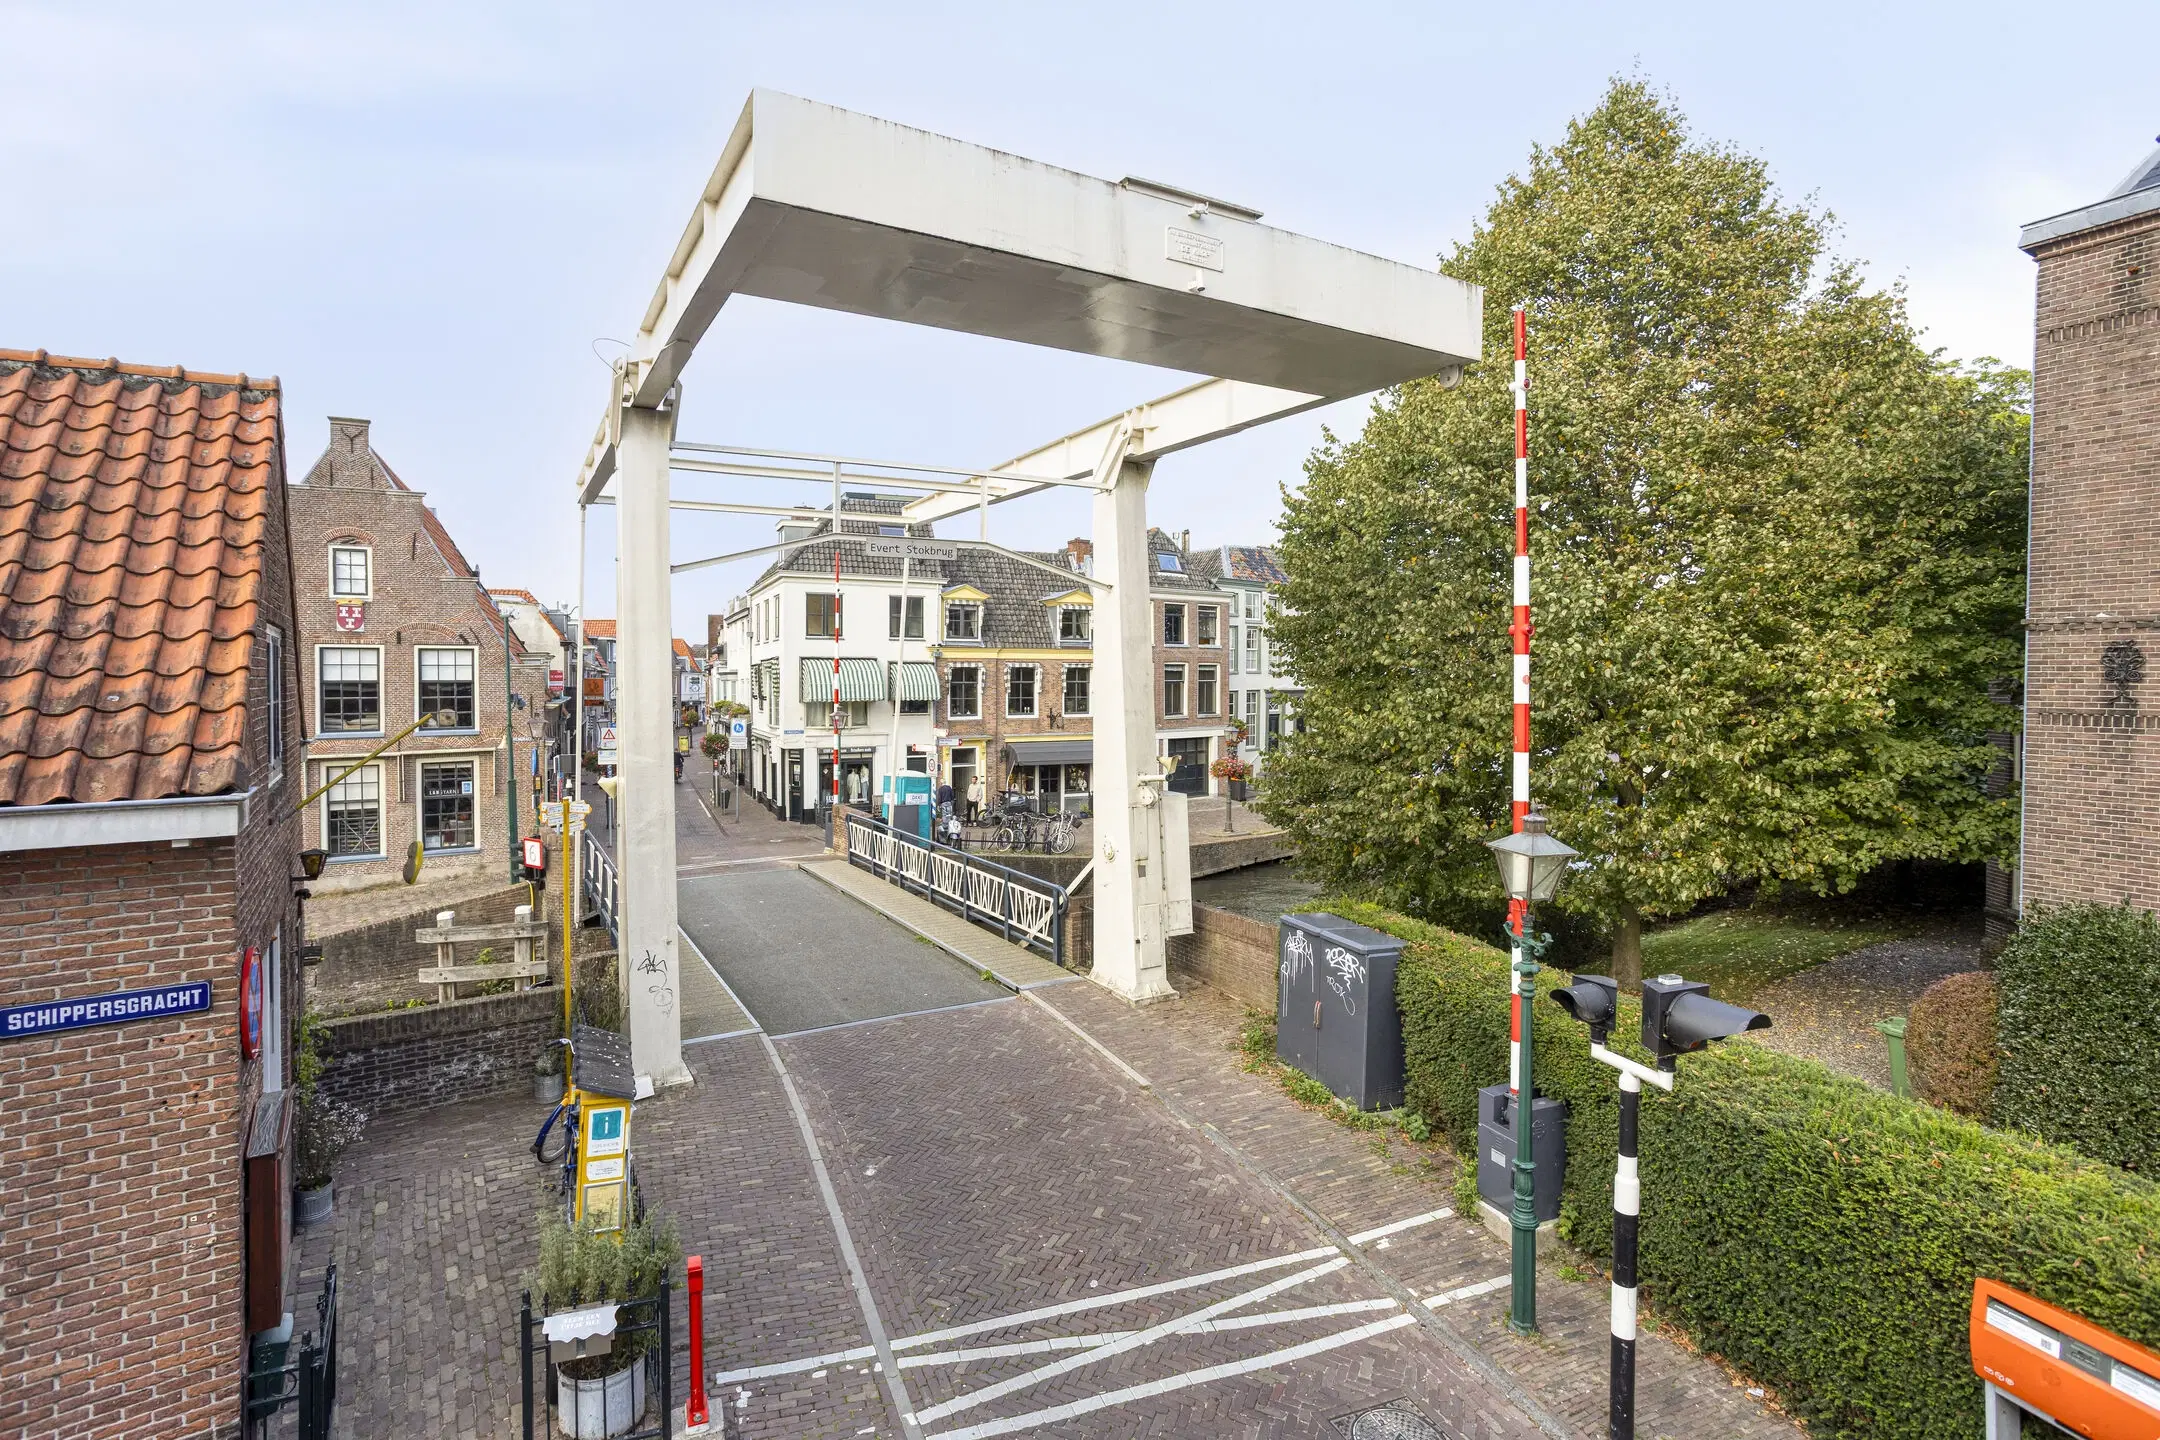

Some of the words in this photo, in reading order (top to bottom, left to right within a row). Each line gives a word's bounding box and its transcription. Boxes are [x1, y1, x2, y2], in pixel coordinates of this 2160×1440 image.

[870, 543, 900, 553] Evert
[906, 544, 953, 558] Stokbrug
[529, 844, 537, 862] 6
[8, 988, 202, 1030] SCHIPPERSGRACHT
